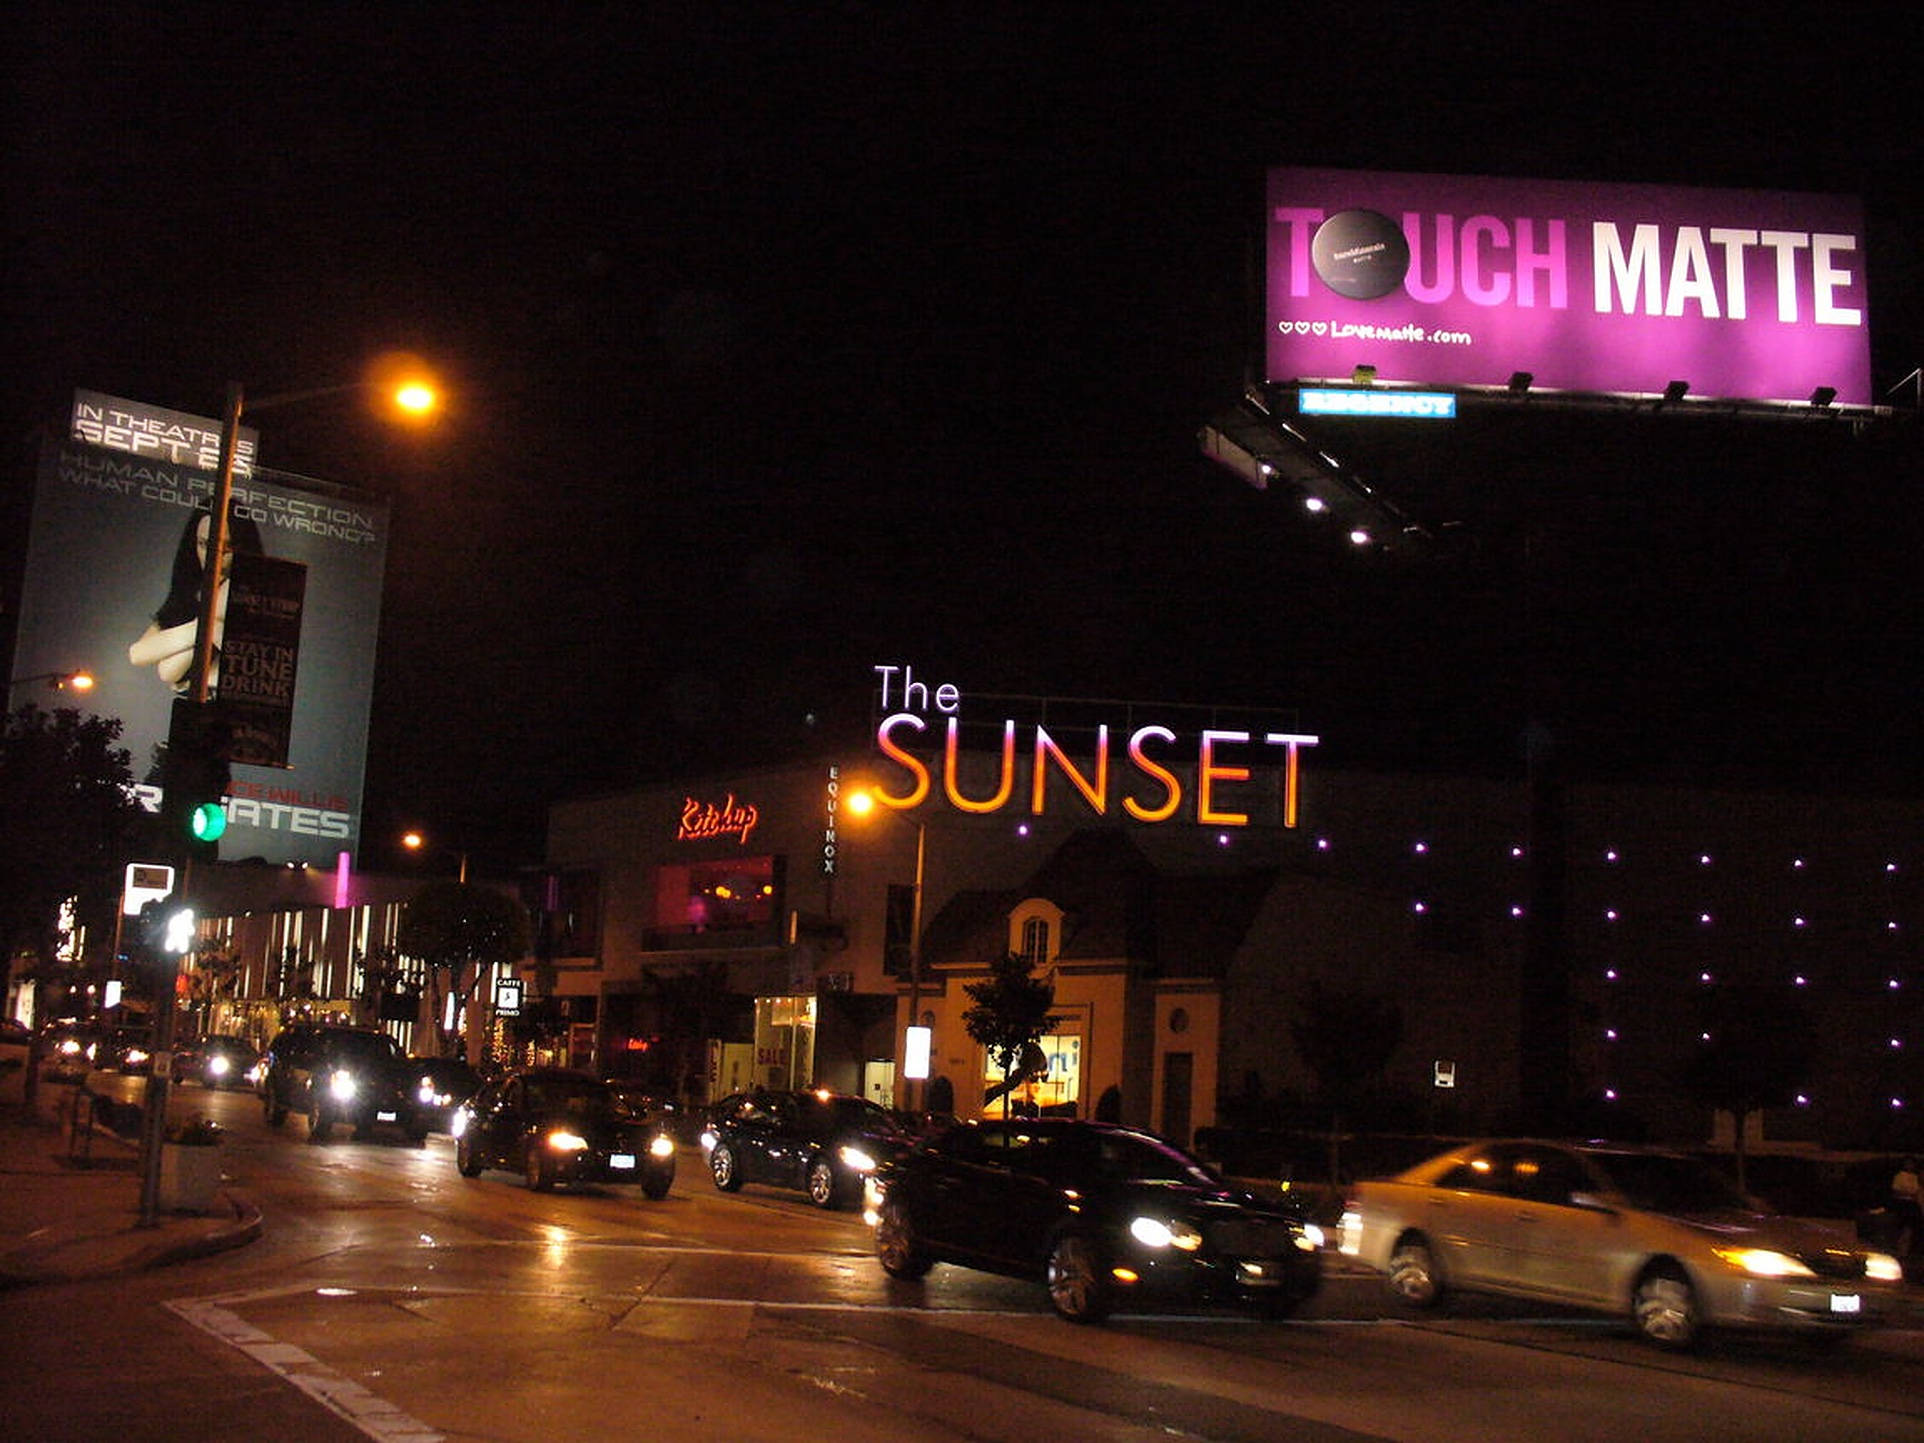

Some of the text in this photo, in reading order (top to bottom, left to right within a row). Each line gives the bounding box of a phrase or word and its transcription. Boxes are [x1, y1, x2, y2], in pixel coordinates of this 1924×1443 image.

[1593, 222, 1862, 326] MATTE
[74, 419, 191, 465] SEPT
[77, 403, 254, 455] IN THEATRS
[57, 467, 135, 495] WHAT
[141, 485, 213, 512] COUL
[59, 451, 178, 487] HUMAN
[224, 655, 294, 681] TUNE
[874, 665, 960, 711] The
[872, 713, 1320, 828] SUNSET
[824, 766, 838, 873] EQUINOX
